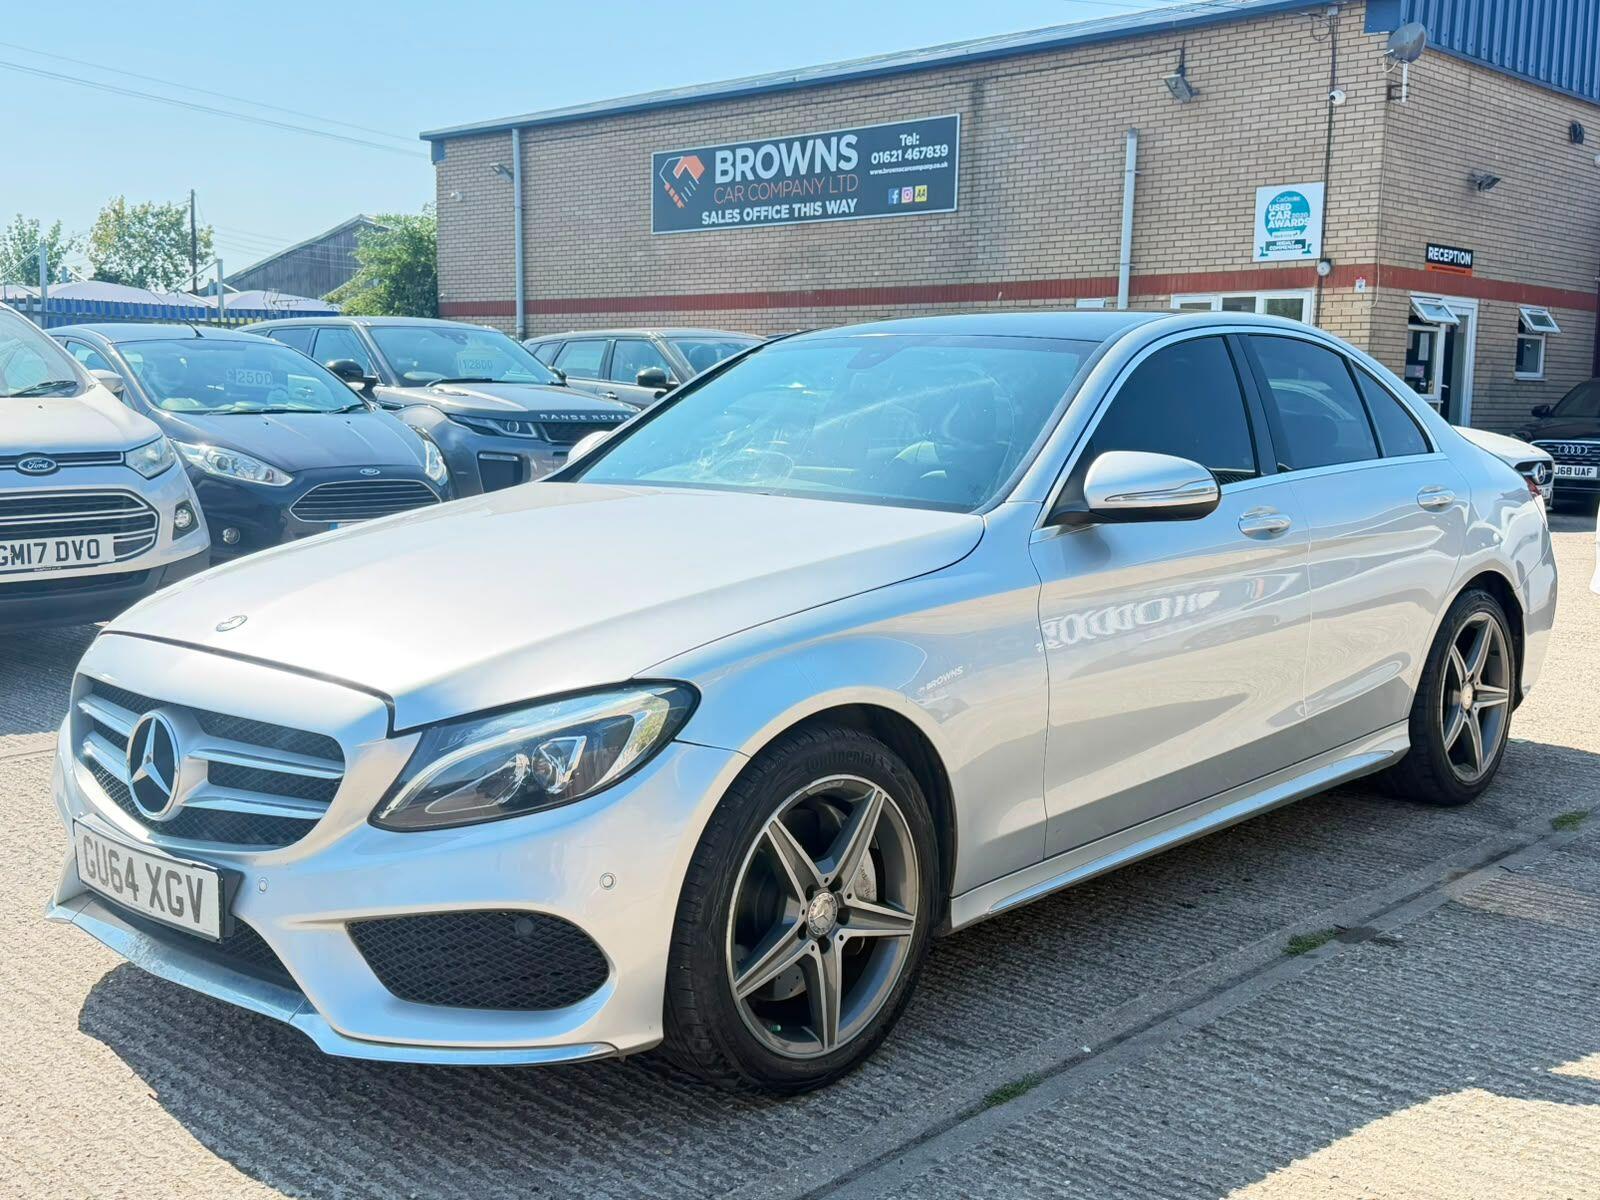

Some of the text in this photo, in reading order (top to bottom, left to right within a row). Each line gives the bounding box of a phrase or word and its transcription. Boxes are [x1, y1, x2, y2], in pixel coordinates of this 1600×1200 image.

[899, 132, 920, 146] Tel:
[715, 134, 859, 184] BROWNS
[871, 144, 949, 165] 01621 467839
[713, 173, 859, 205] CAR COMPANY LTD
[701, 198, 858, 225] SALES OFFICE THIS WAY
[1268, 202, 1292, 212] USED
[1267, 217, 1311, 229] AWARDS
[1268, 211, 1291, 220] CAR
[1427, 246, 1472, 265] RECEPTION
[540, 413, 587, 421] RANGE
[27, 460, 49, 469] Ford
[1574, 467, 1593, 477] UAF
[55, 538, 100, 562] DVO
[83, 834, 204, 924] GU64 XGV
